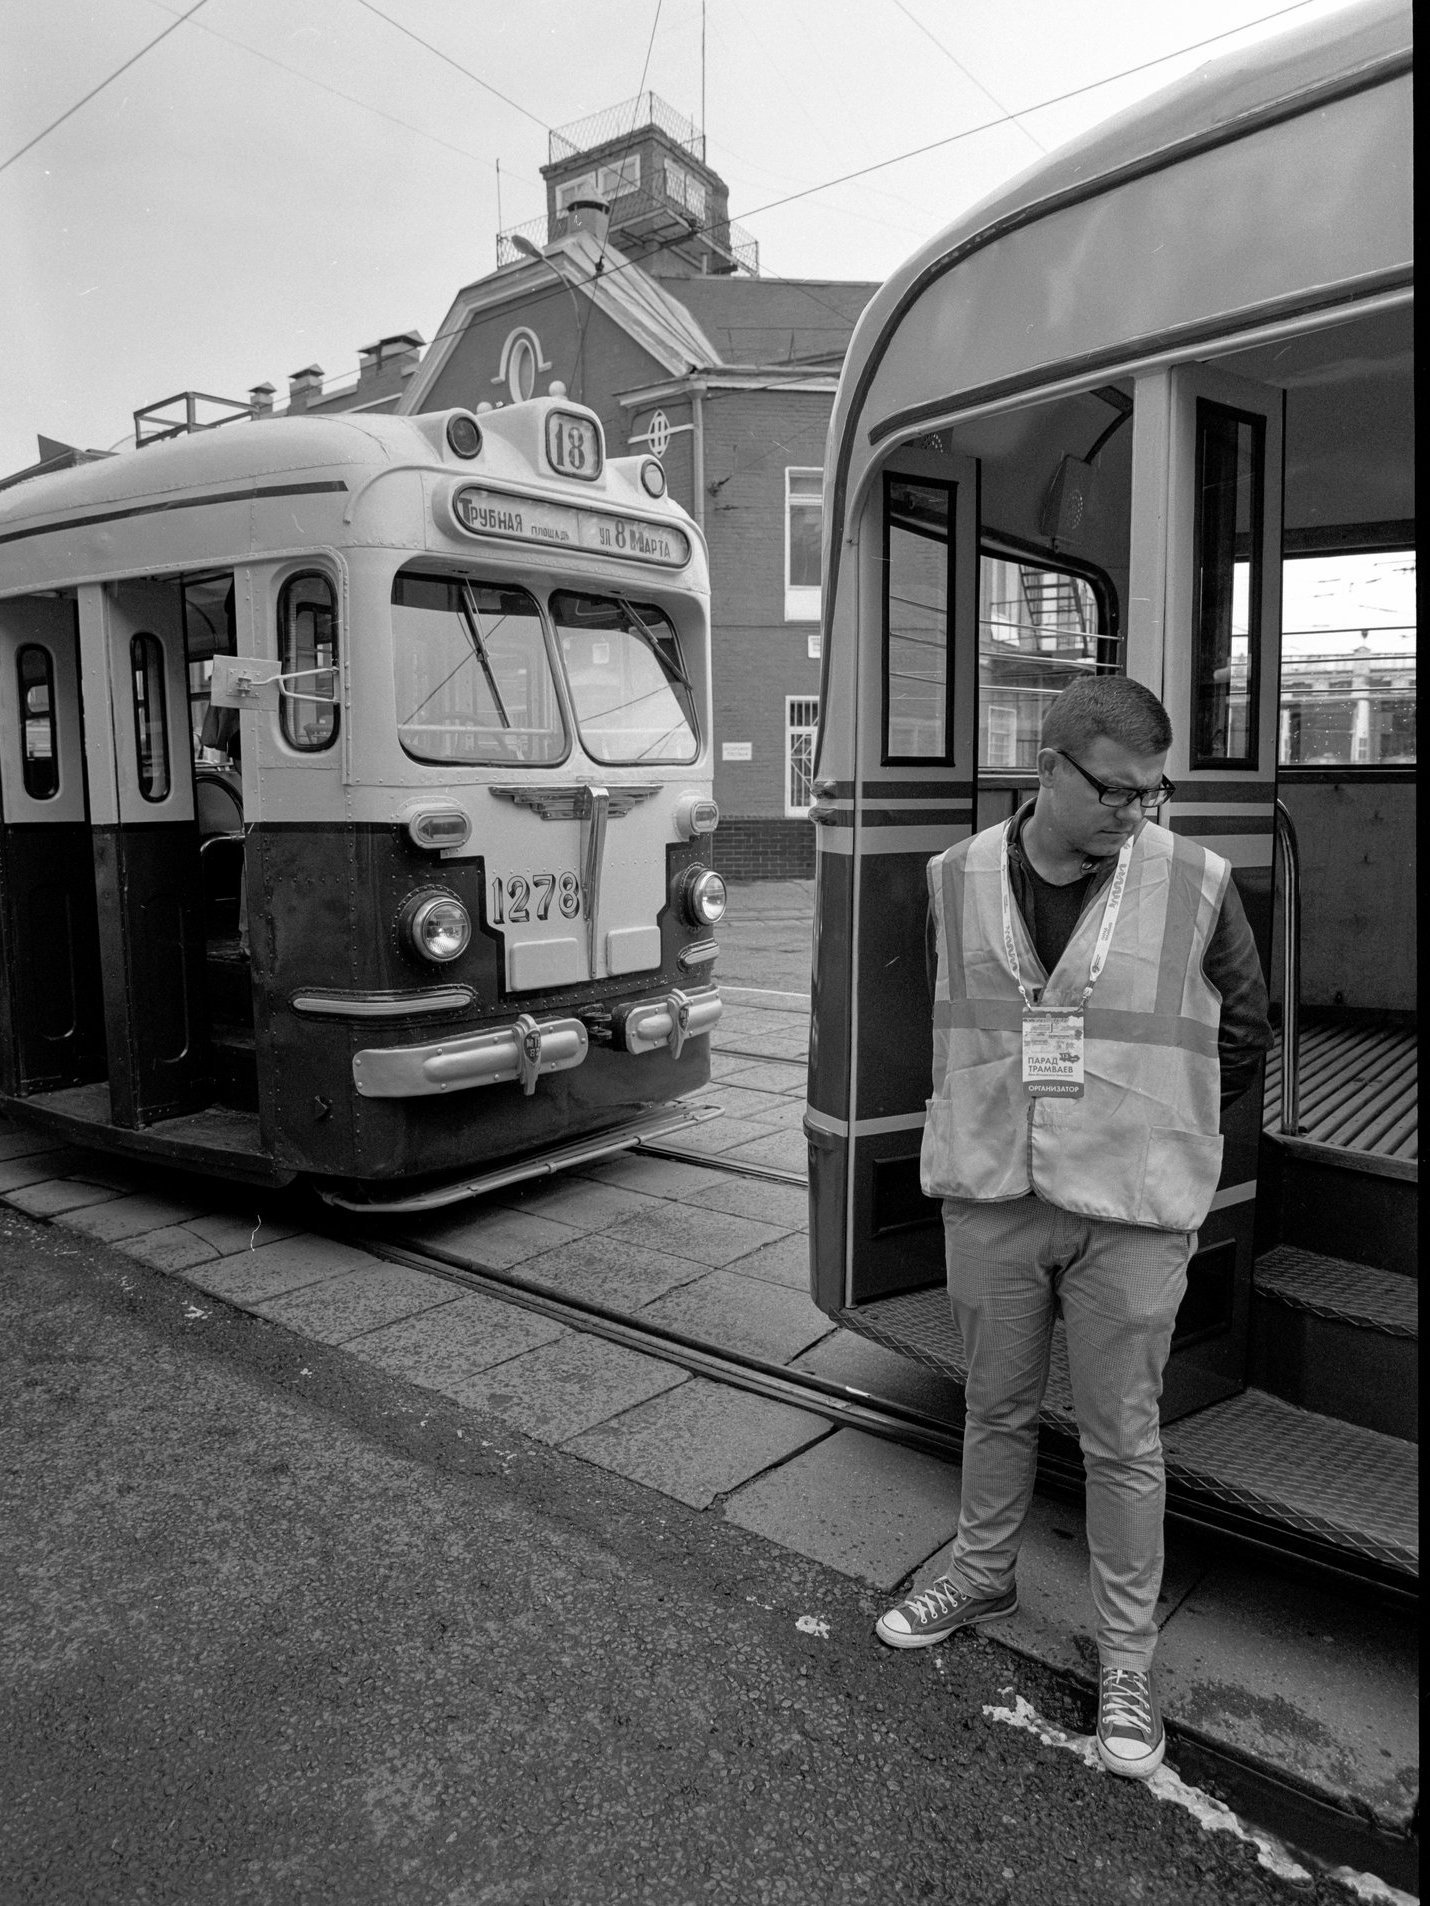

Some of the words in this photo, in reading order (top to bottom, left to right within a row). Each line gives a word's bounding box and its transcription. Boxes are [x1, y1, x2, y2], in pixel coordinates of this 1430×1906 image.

[555, 423, 585, 470] 18
[459, 498, 523, 532] ТРУБНАЯ
[615, 520, 626, 549] 8
[629, 529, 671, 558] МАРТА
[492, 871, 580, 925] 1278
[1028, 1057, 1058, 1066] ПАРАД
[1028, 1065, 1074, 1073] ТРАМВАЕВ
[1028, 1084, 1080, 1093] ОРГАНИЗАТОР
